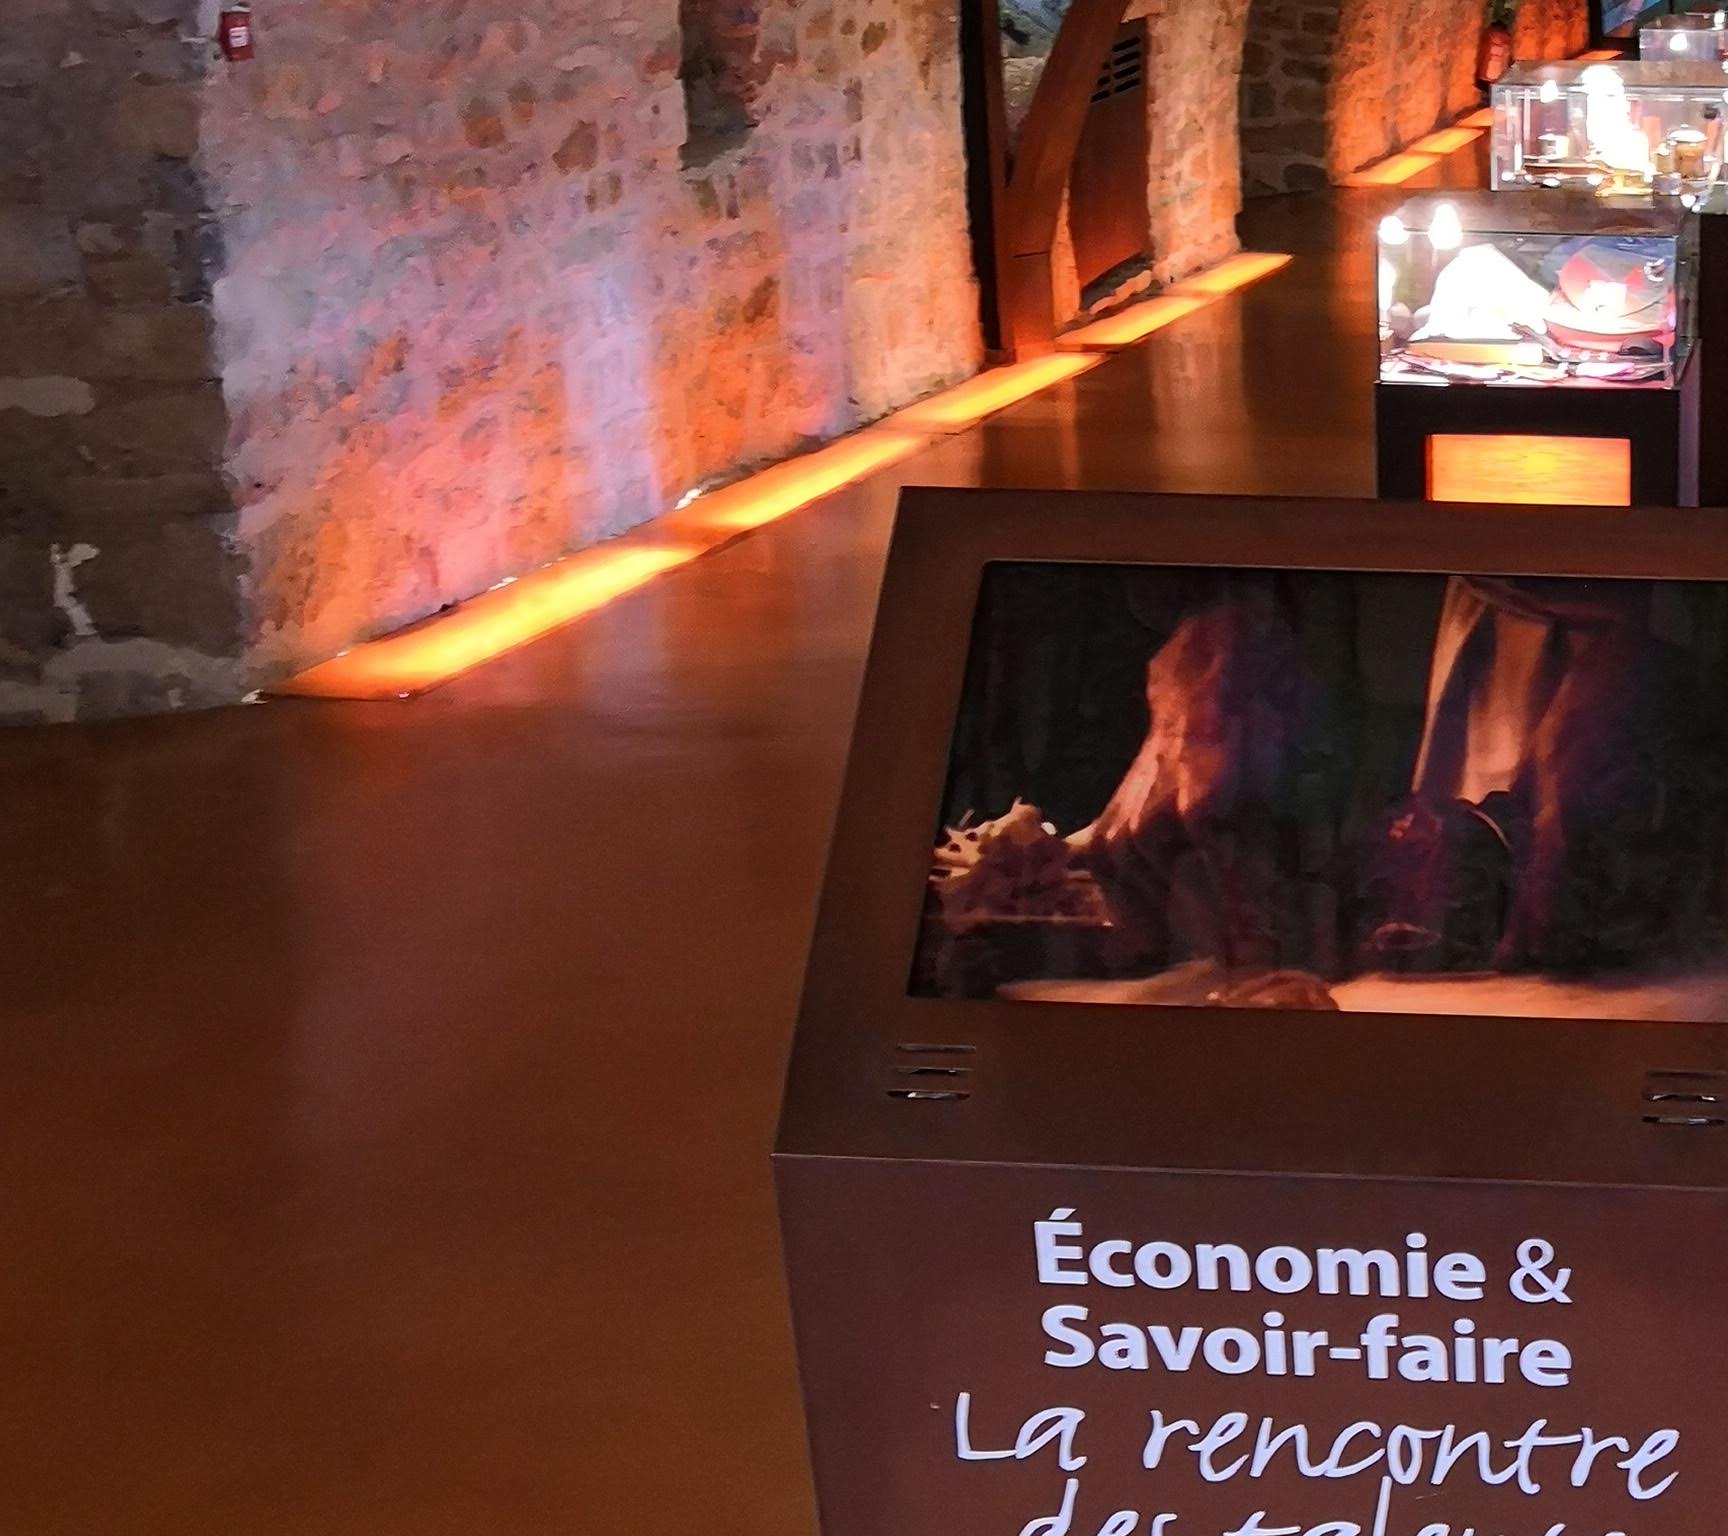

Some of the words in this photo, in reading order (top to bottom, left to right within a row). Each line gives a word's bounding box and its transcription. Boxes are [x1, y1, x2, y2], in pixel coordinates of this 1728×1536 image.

[1033, 1207, 1487, 1301] Économie
[1509, 1238, 1573, 1304] &
[1041, 1304, 1573, 1387] Savoir-faire
[955, 1391, 1088, 1472] La
[1142, 1409, 1680, 1500] rencontre
